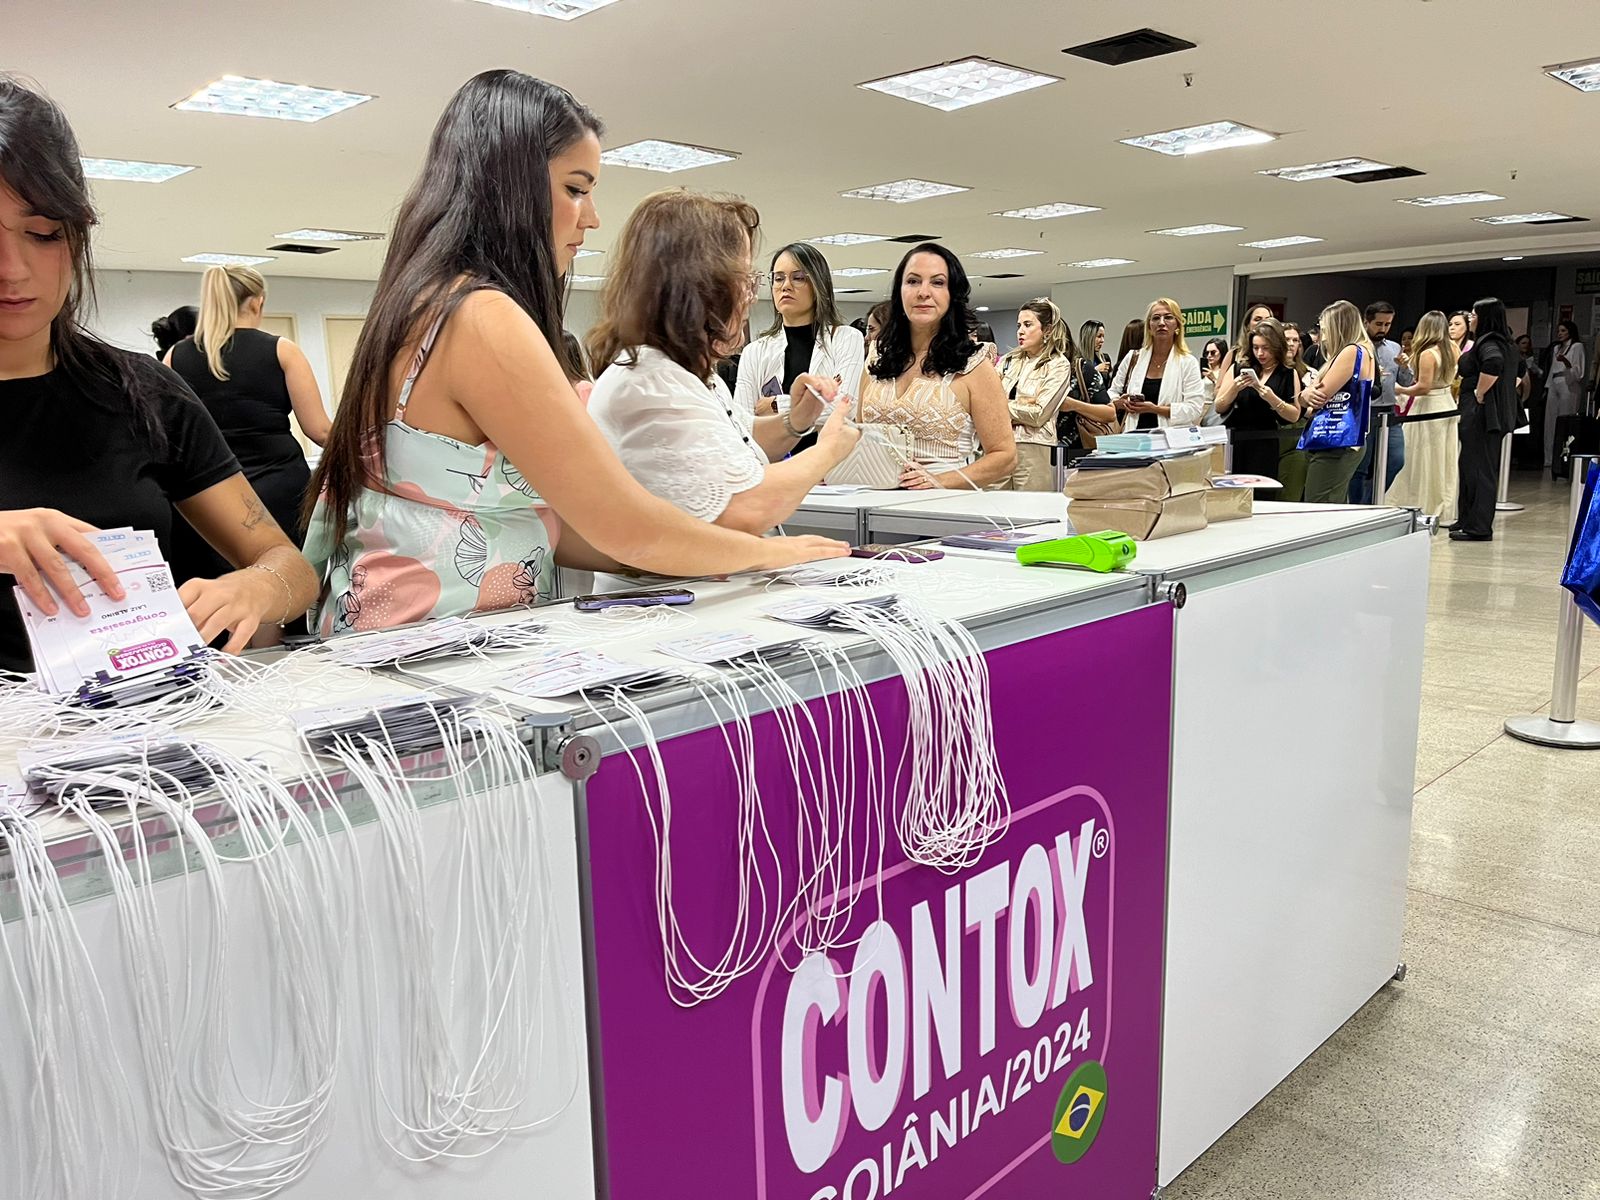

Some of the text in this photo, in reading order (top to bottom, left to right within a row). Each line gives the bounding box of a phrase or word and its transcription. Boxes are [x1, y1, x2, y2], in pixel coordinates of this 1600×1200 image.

[1181, 309, 1212, 326] SAÍDA
[90, 611, 168, 634] Congressista
[101, 608, 129, 620] ALBINO
[116, 645, 174, 669] CONTOX
